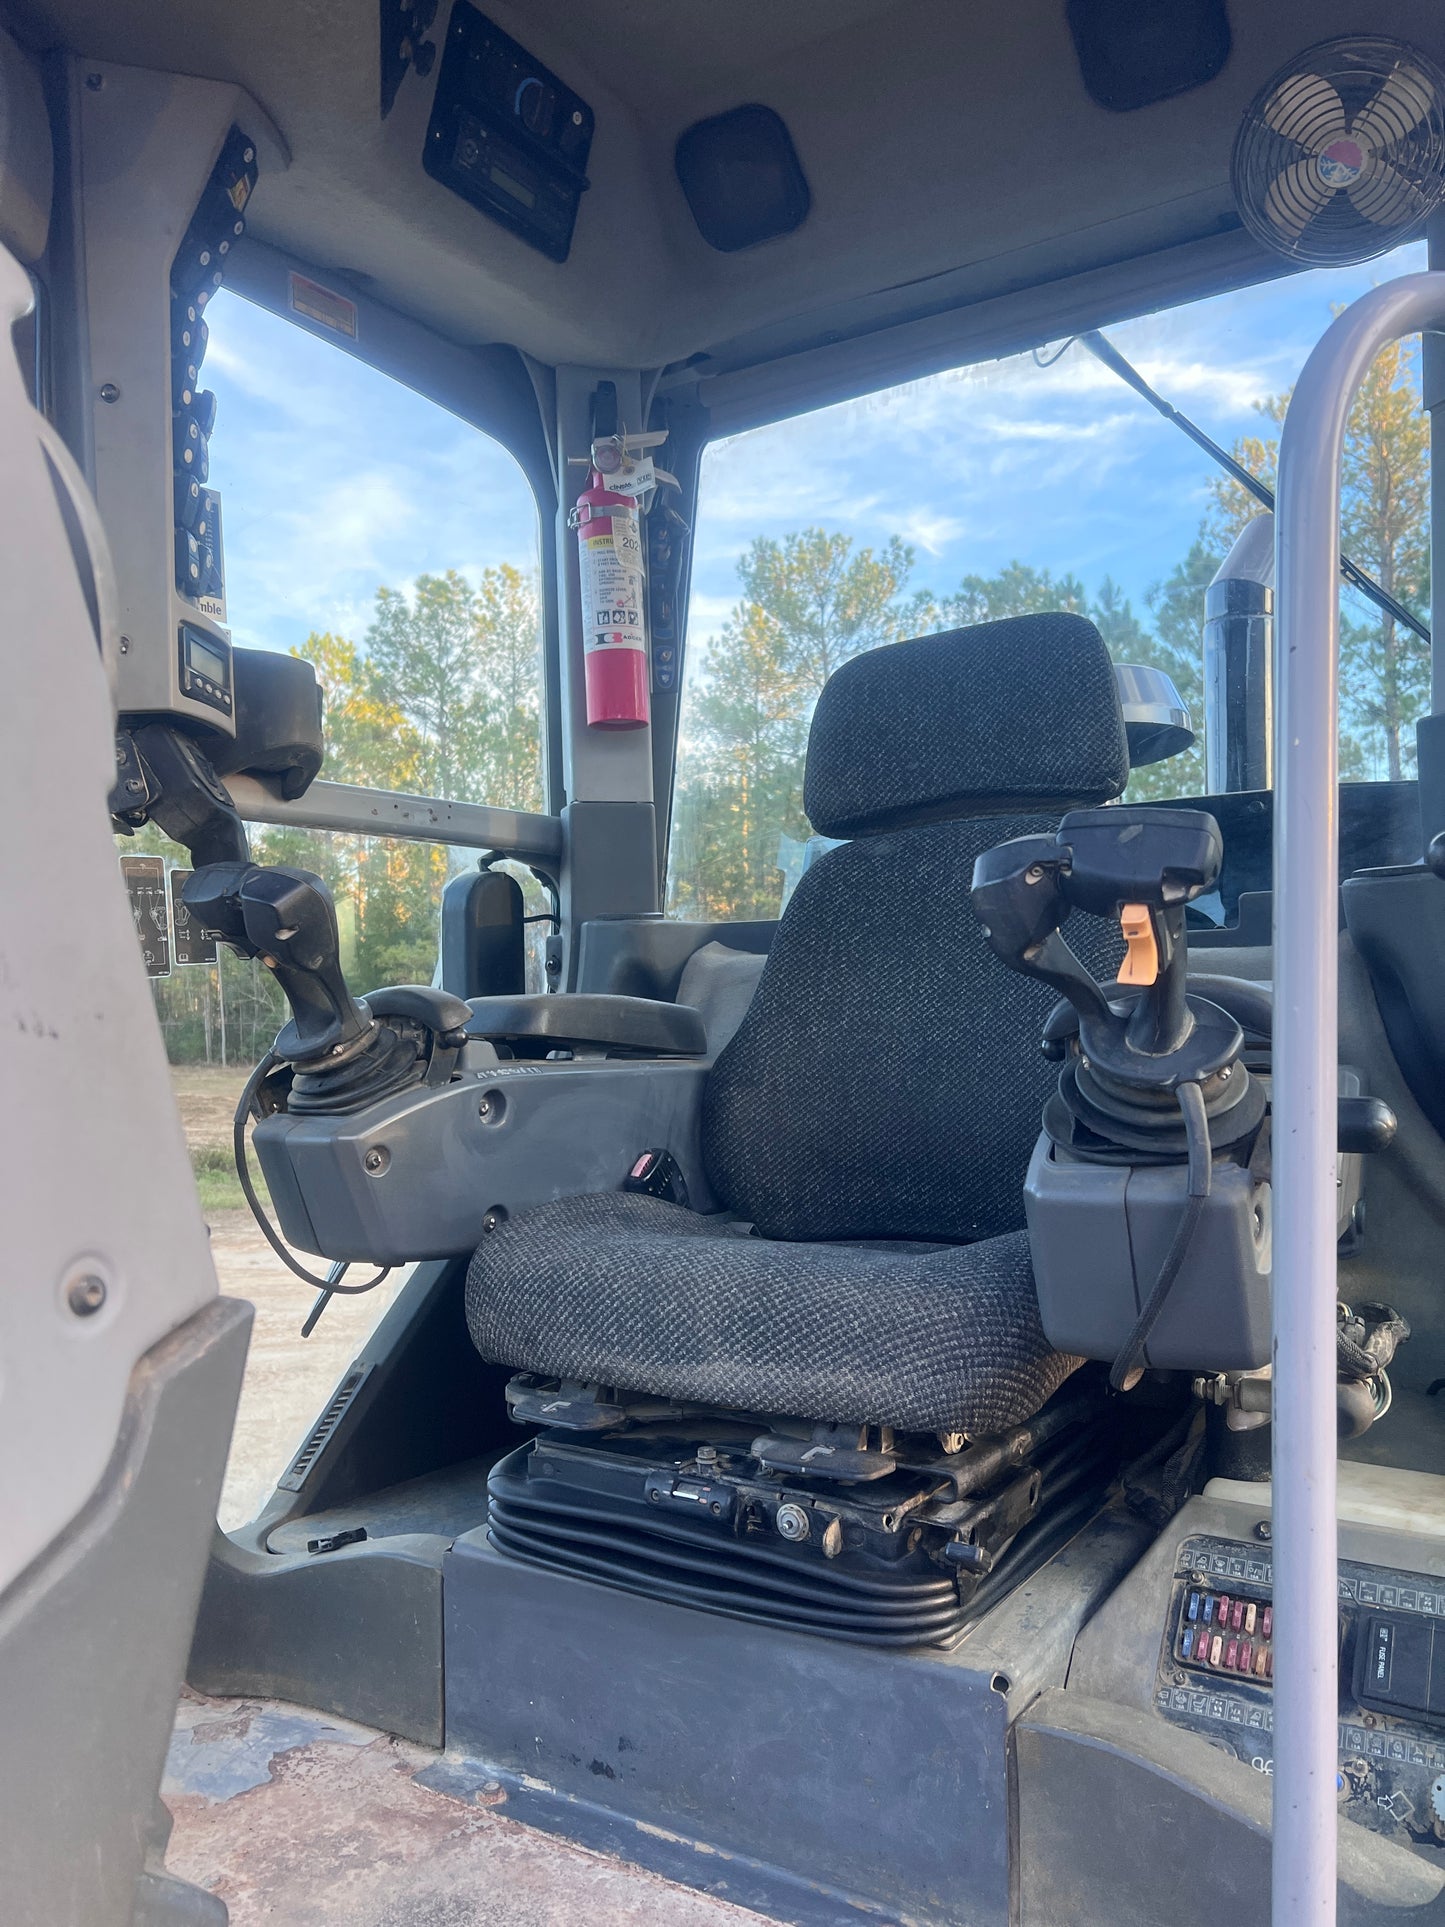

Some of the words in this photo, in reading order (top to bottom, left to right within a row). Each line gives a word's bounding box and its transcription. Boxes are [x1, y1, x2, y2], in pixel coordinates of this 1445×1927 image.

[592, 538, 614, 546] INSTRU
[622, 537, 640, 552] 202
[200, 601, 222, 615] mble
[1378, 1646, 1387, 1661] FUSE
[1377, 1661, 1385, 1679] PANEL
